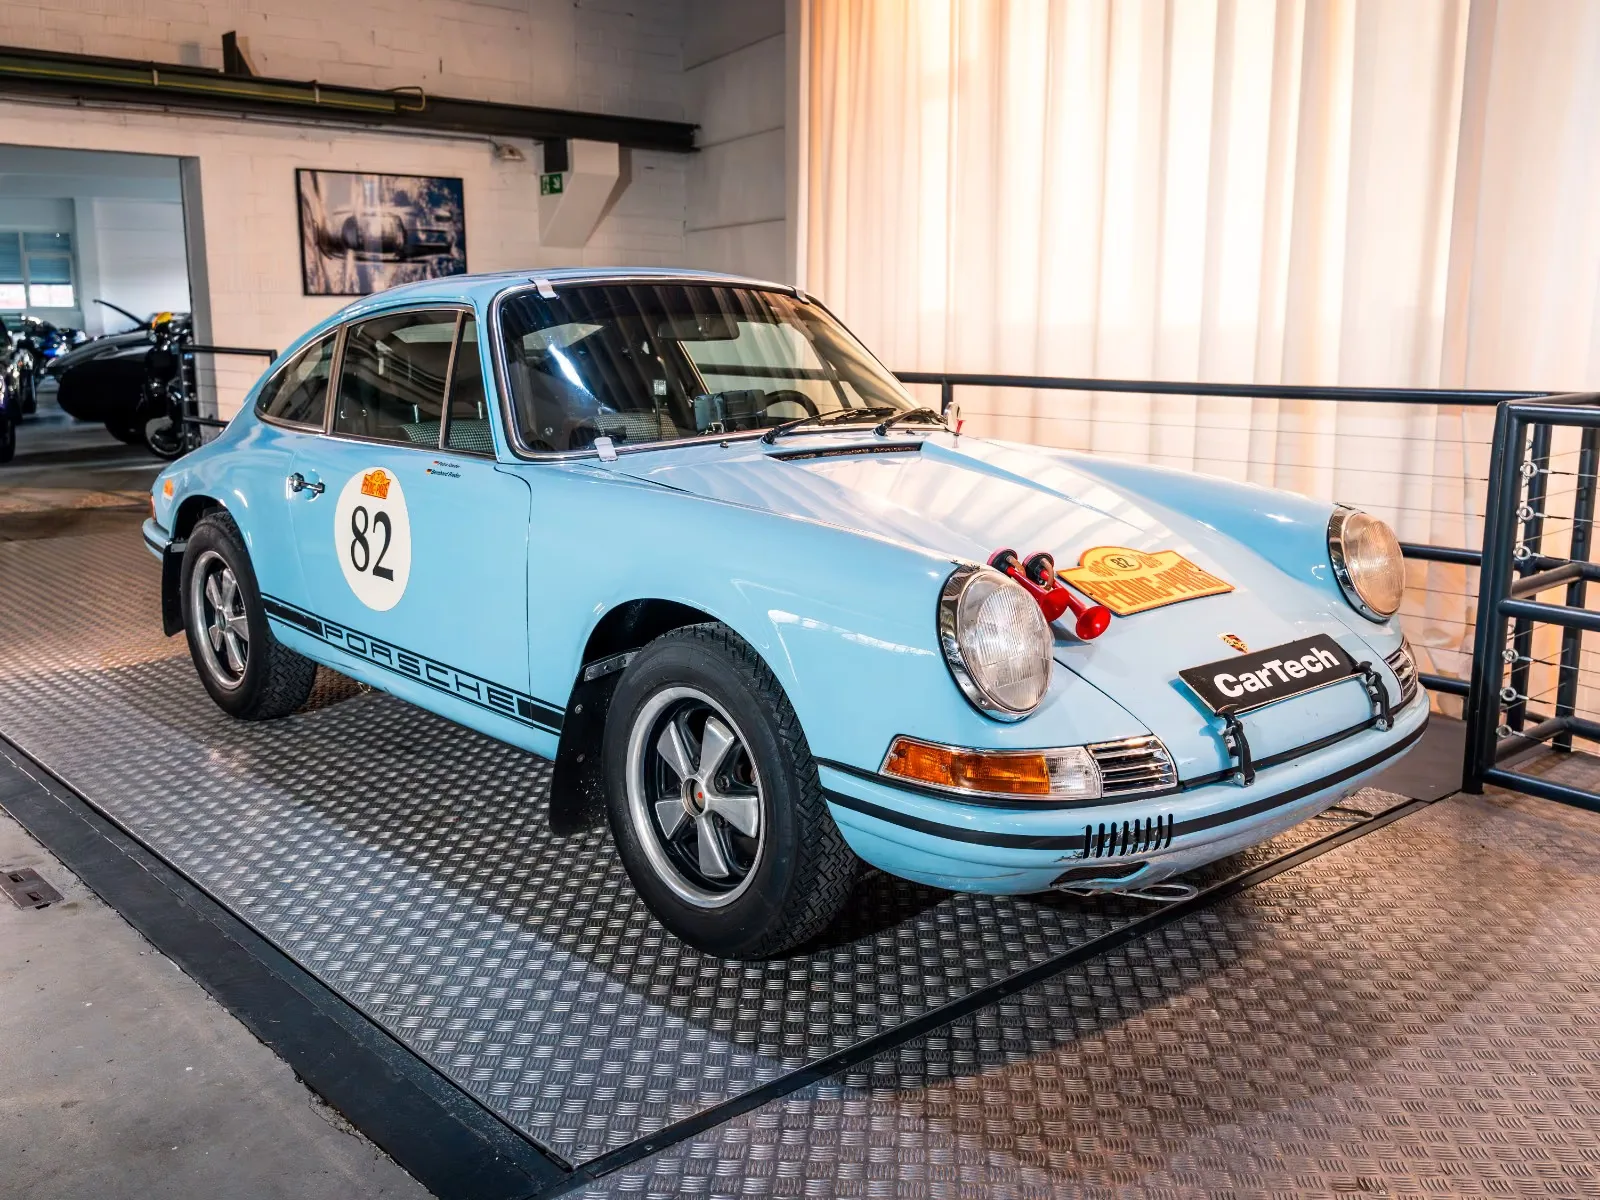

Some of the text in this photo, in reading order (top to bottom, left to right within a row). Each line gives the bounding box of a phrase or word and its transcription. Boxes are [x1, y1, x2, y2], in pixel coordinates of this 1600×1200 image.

[351, 505, 394, 582] 82
[1110, 557, 1134, 568] 82
[1073, 559, 1225, 609] PEKING PARIS
[323, 623, 516, 714] PORSCHE
[1213, 647, 1341, 698] CarTech
